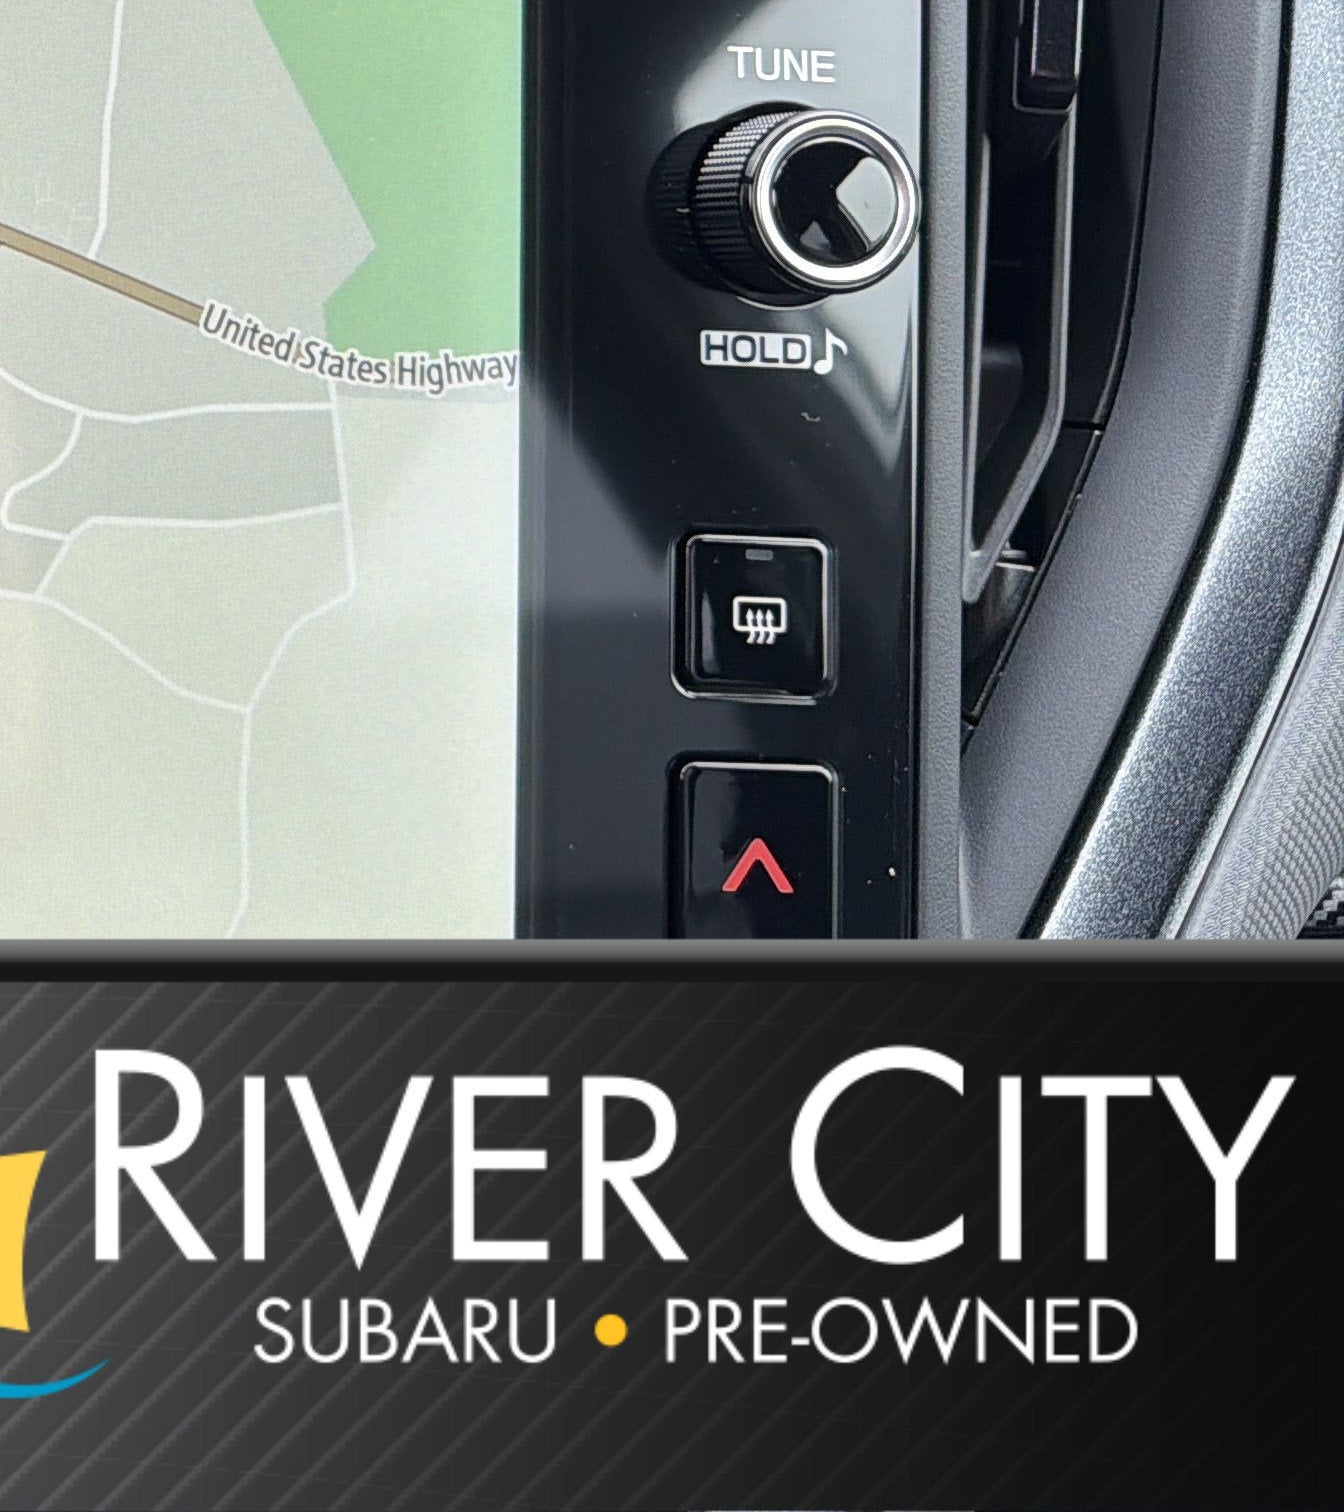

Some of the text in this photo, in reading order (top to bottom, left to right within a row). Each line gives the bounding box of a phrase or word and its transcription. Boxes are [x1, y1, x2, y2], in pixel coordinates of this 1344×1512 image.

[726, 45, 836, 83] TUNE
[202, 303, 518, 395] United States Highway
[703, 333, 808, 364] HOLD
